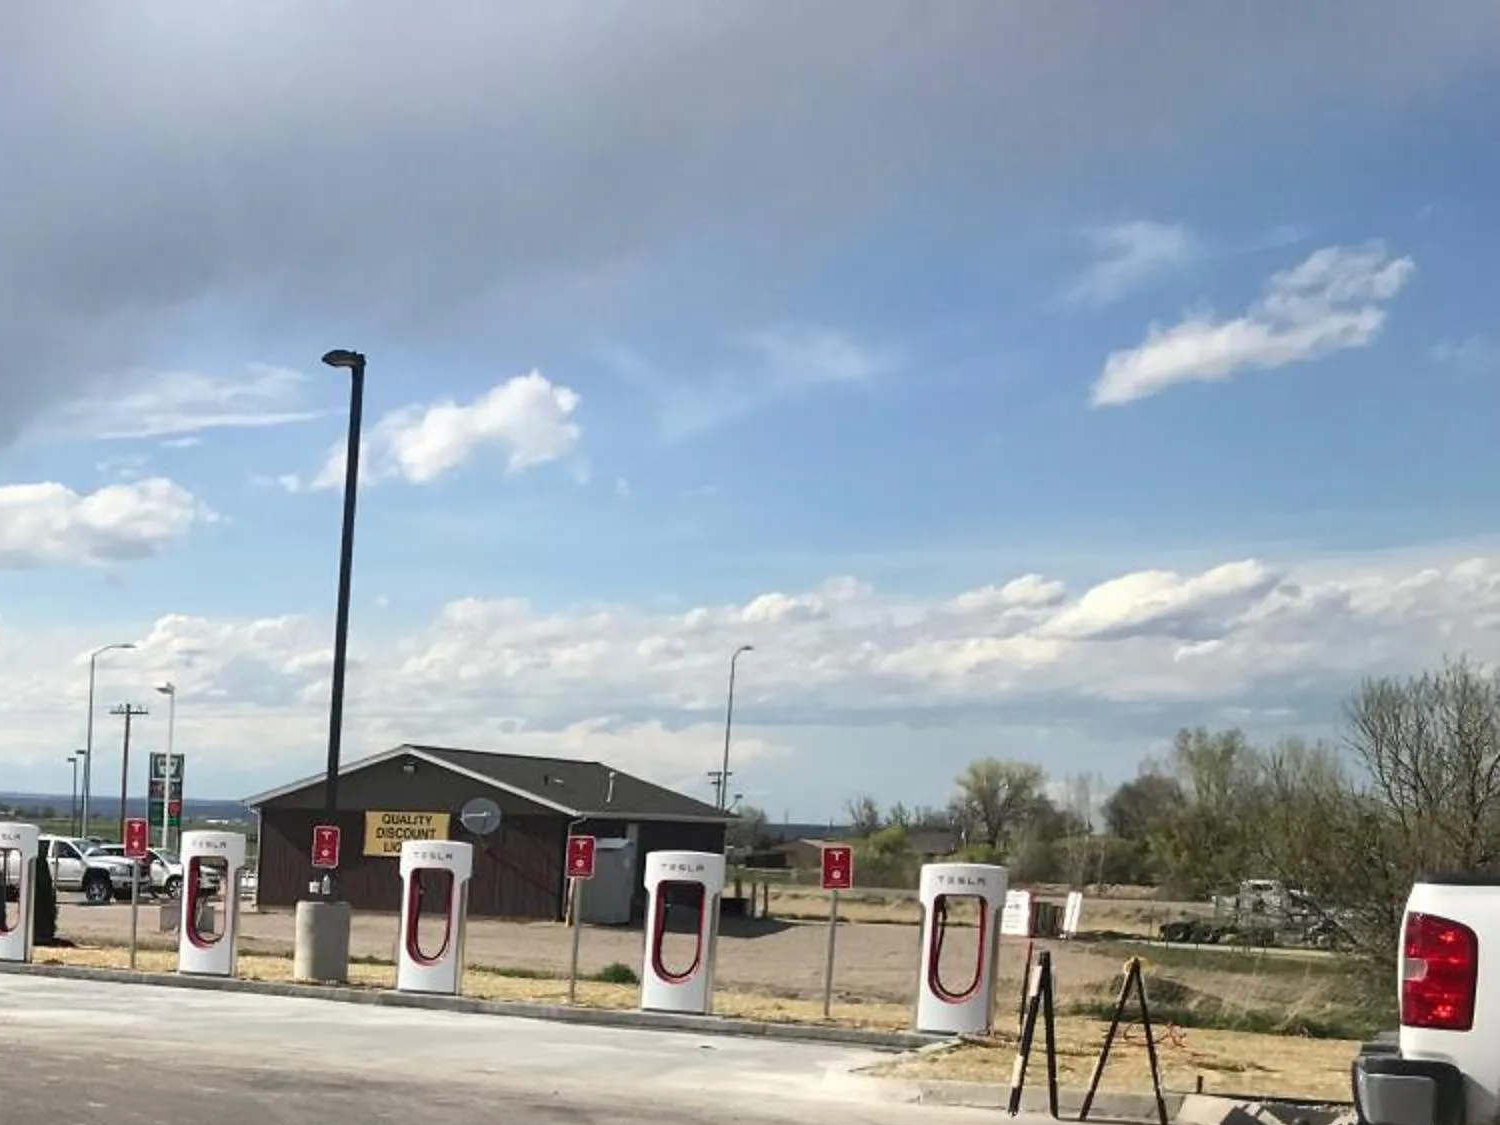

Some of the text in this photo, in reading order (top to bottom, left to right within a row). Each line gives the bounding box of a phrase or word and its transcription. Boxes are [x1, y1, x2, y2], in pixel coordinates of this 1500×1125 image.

[381, 813, 433, 825] QUALITY
[375, 827, 437, 840] DISCOUNT
[413, 851, 453, 861] TESLA
[660, 863, 705, 873] TESLA
[937, 875, 987, 887] TESLA
